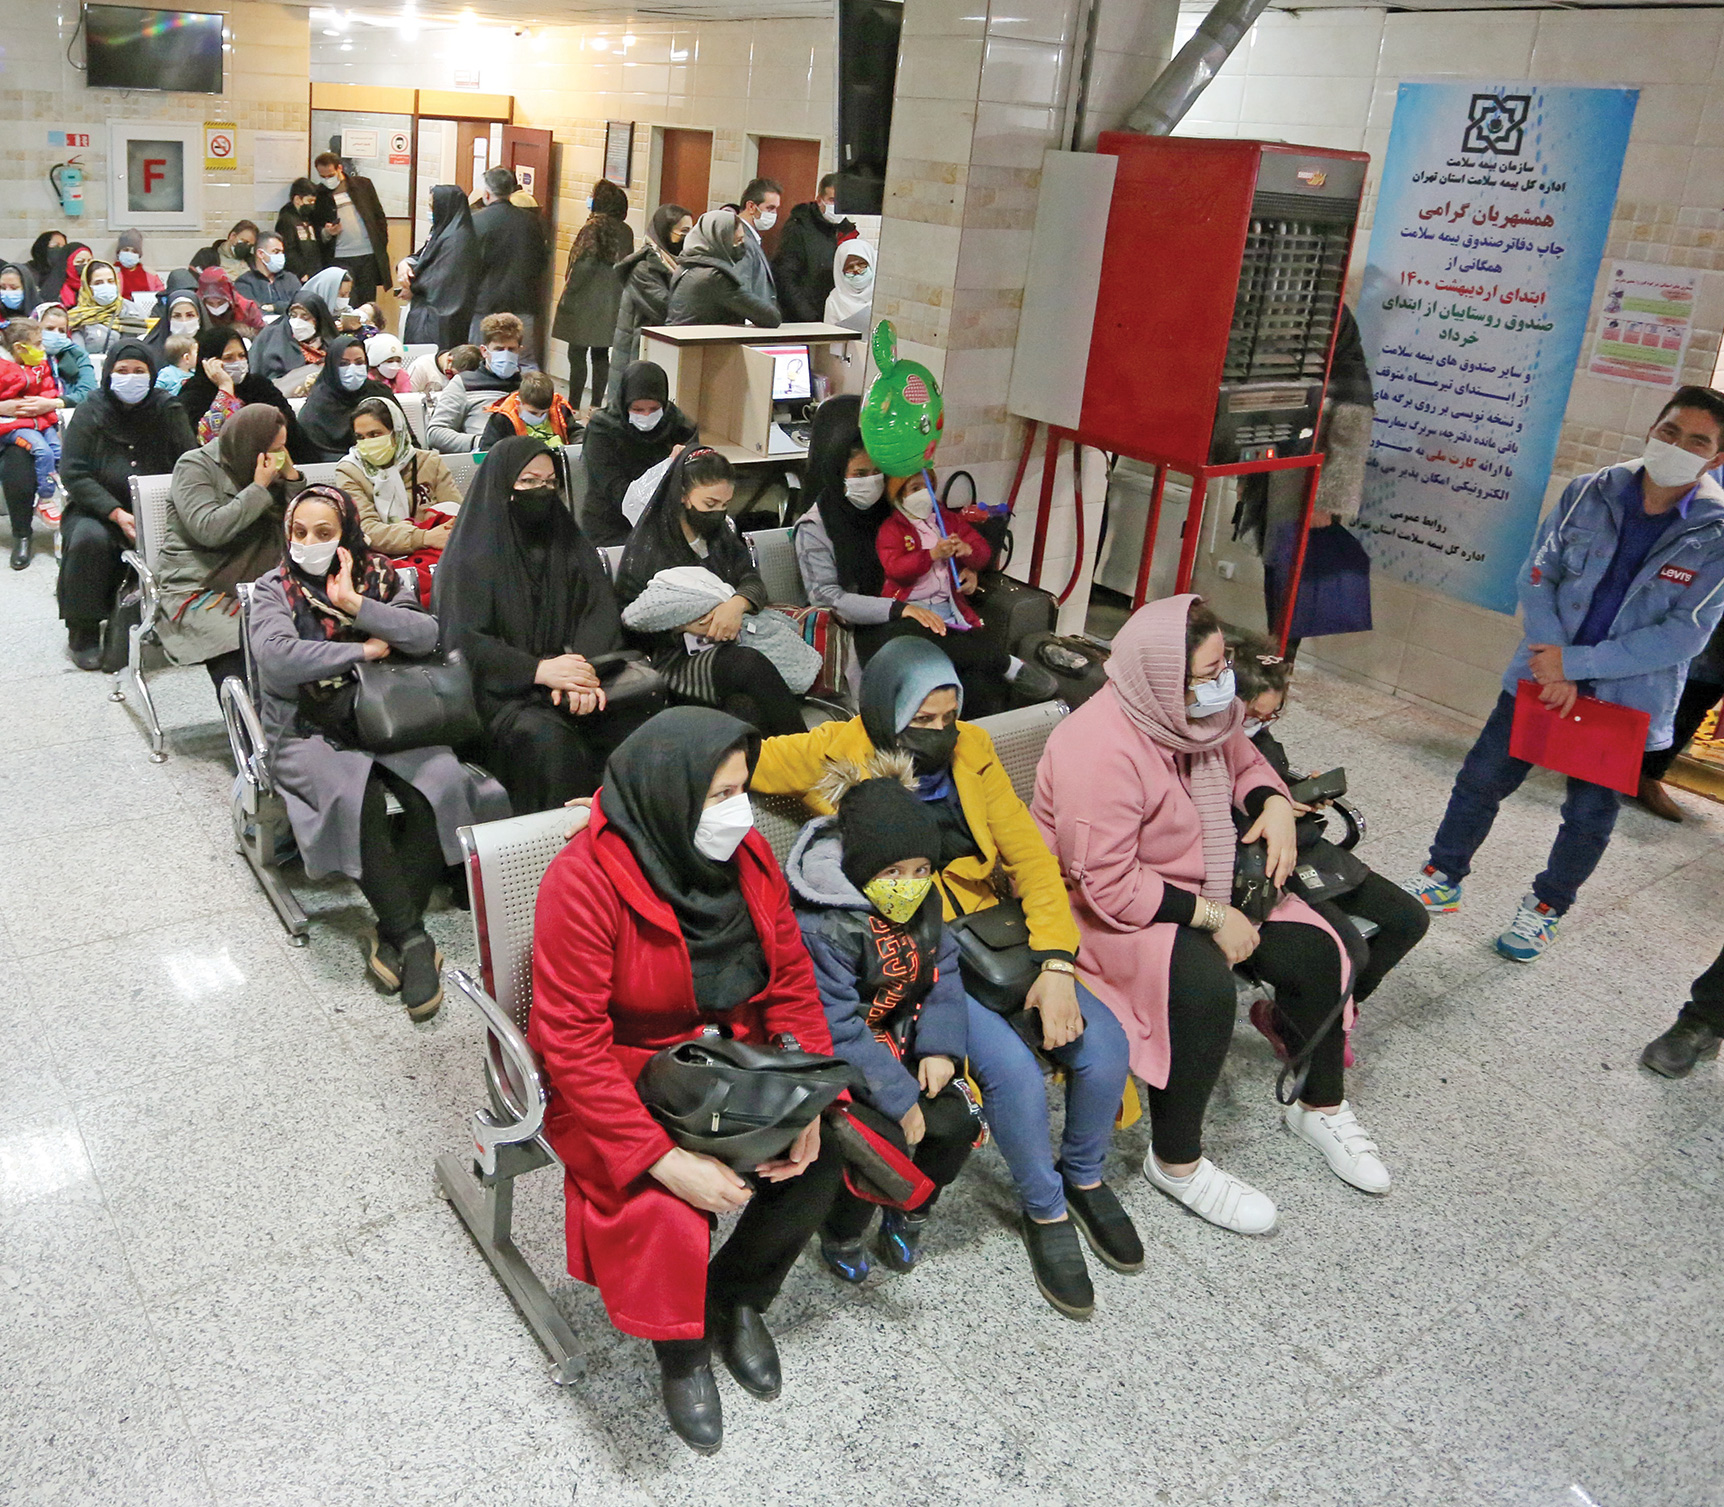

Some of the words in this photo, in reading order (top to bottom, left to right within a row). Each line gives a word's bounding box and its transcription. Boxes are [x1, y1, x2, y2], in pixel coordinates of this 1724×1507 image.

[1446, 157, 1475, 168] سلامت
[1478, 161, 1497, 172] بیمه
[1498, 161, 1535, 174] سازمان
[143, 159, 166, 193] F
[1412, 171, 1438, 184] تهران
[1439, 173, 1465, 184] استان
[1467, 175, 1497, 187] سلامت
[1500, 180, 1518, 191] بیمه
[1521, 179, 1537, 191] کل
[1539, 181, 1567, 194] اداره
[1418, 201, 1470, 223] گرامی
[1472, 204, 1555, 228] همشهریان
[1400, 226, 1435, 240] سلامت
[1438, 232, 1460, 246] بیمه
[1462, 234, 1503, 249] صندوق
[1503, 237, 1534, 253] دفاتر
[1537, 241, 1565, 259] چاپ
[1445, 255, 1458, 271] از
[1459, 258, 1502, 273] همگانی
[1400, 270, 1431, 287] ۱۴۰۰
[1435, 279, 1498, 302] اردیبهشت
[1382, 295, 1422, 314] ابتدای
[1499, 288, 1546, 308] ابتدای
[1423, 301, 1438, 317] از
[1439, 303, 1501, 329] روستاییان
[1504, 315, 1555, 332] صندوق
[1438, 328, 1480, 347] خرداد
[1382, 345, 1413, 358] سلامت
[1415, 351, 1434, 365] بیمه
[1436, 355, 1457, 367] های
[1459, 360, 1497, 373] صندوق
[1376, 366, 1405, 382] متوقف
[1498, 366, 1522, 378] سایر
[1523, 372, 1531, 384] و
[1373, 389, 1389, 401] های
[1392, 393, 1413, 409] برگه
[1517, 394, 1529, 407] از
[1414, 402, 1436, 414] روی
[1438, 406, 1449, 417] بر
[1451, 410, 1485, 424] نویسی
[1487, 413, 1514, 427] نسخه
[1516, 422, 1523, 432] و
[1473, 436, 1497, 449] مانده
[1426, 449, 1447, 462] ملی
[1497, 443, 1519, 456] باقی
[1449, 456, 1477, 469] کارت
[1420, 472, 1450, 486] امکان
[1451, 481, 1509, 500] الکترونیکی
[1348, 517, 1371, 530] تهران
[1390, 511, 1419, 523] عمومی
[1372, 524, 1396, 537] استان
[1422, 516, 1447, 534] روابط
[1397, 531, 1424, 544] سلامت
[1427, 540, 1443, 552] بیمه
[1445, 544, 1460, 555] کل
[1461, 549, 1485, 562] اداره
